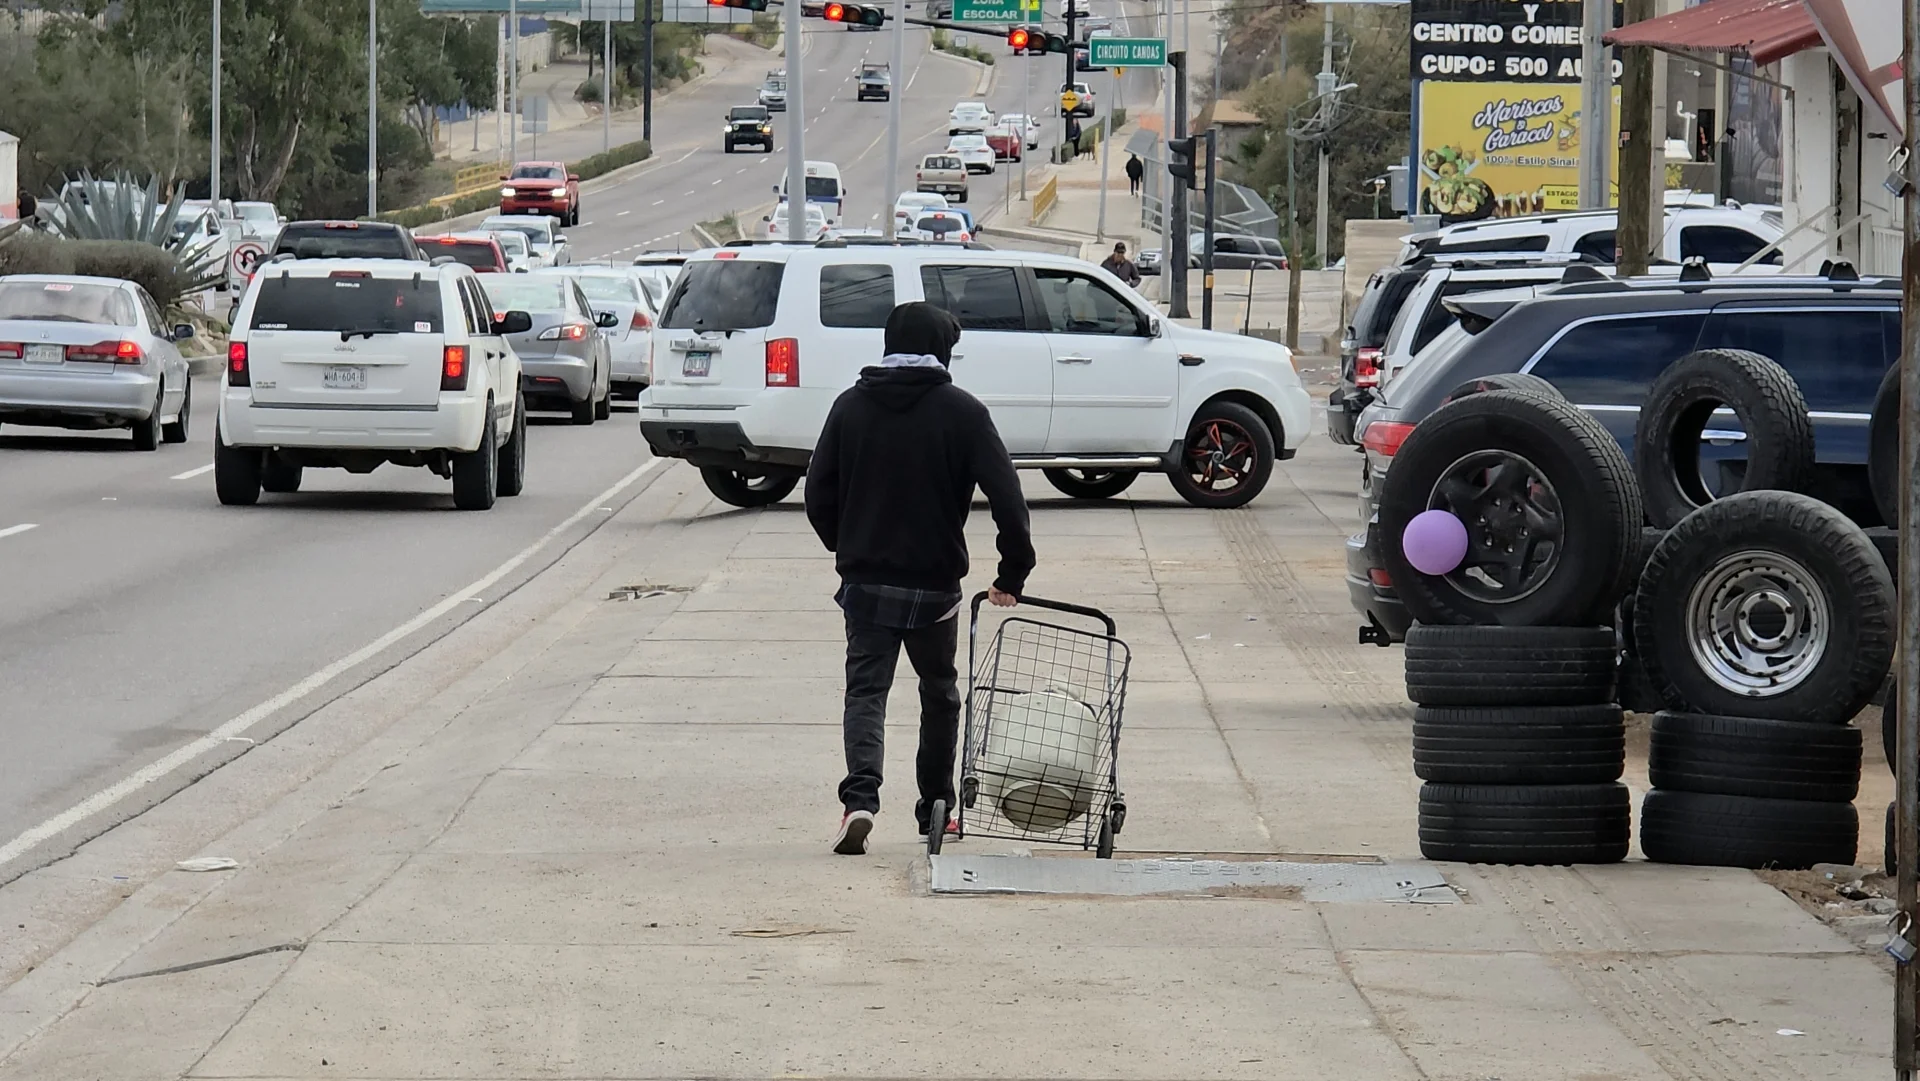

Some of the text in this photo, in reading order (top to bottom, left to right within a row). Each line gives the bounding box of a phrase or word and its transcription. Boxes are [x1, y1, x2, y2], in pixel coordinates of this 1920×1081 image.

[963, 9, 1018, 19] ESCOLAR
[1523, 4, 1539, 23] Y
[1413, 23, 1583, 45] CENTRO COME
[1097, 44, 1129, 59] CIRCUITO
[1420, 55, 1496, 75] CUPO:
[1505, 57, 1548, 76] 500
[1474, 96, 1563, 128] Mariscos
[1517, 156, 1546, 165] Estilo
